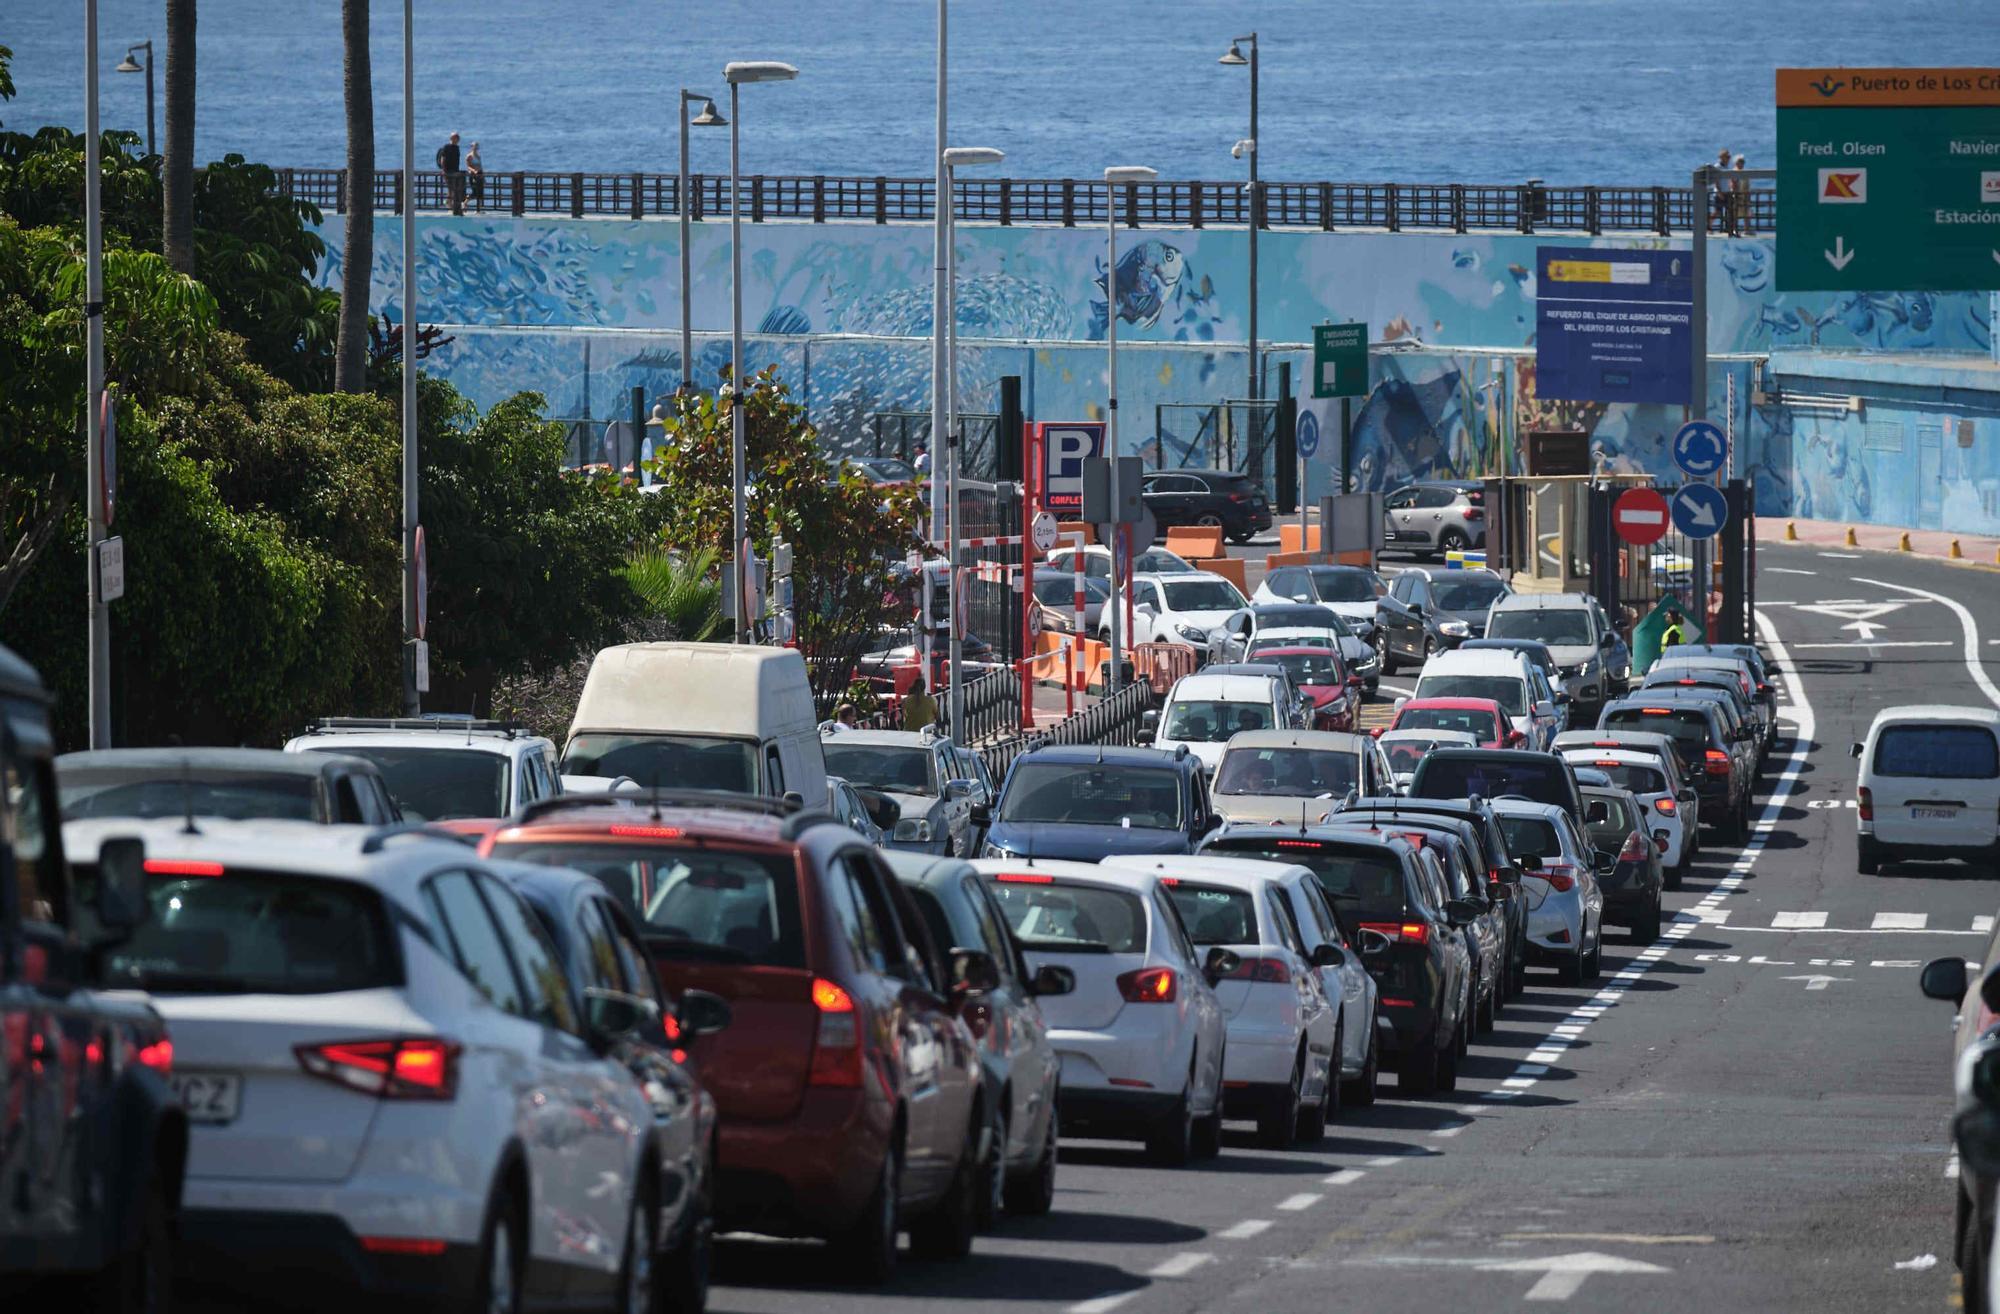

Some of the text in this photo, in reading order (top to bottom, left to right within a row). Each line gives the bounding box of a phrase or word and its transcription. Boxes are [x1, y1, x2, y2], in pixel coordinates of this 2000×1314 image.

[1852, 76, 1910, 91] Puerto
[1916, 75, 1937, 91] de
[1943, 75, 1971, 91] Los
[1800, 142, 1886, 155] Fred. Olsen
[1935, 208, 2000, 224] Estación
[1546, 310, 1582, 319] REFUERZO
[1583, 311, 1596, 320] DEL
[1596, 311, 1618, 321] DIQUE
[1618, 312, 1629, 321] DE
[1629, 312, 1656, 322] ABRIGO
[1564, 323, 1577, 331] DEL
[1578, 324, 1604, 332] PUERTO
[1605, 325, 1615, 333] DE
[1616, 325, 1629, 334] LOS
[1048, 430, 1093, 475] P
